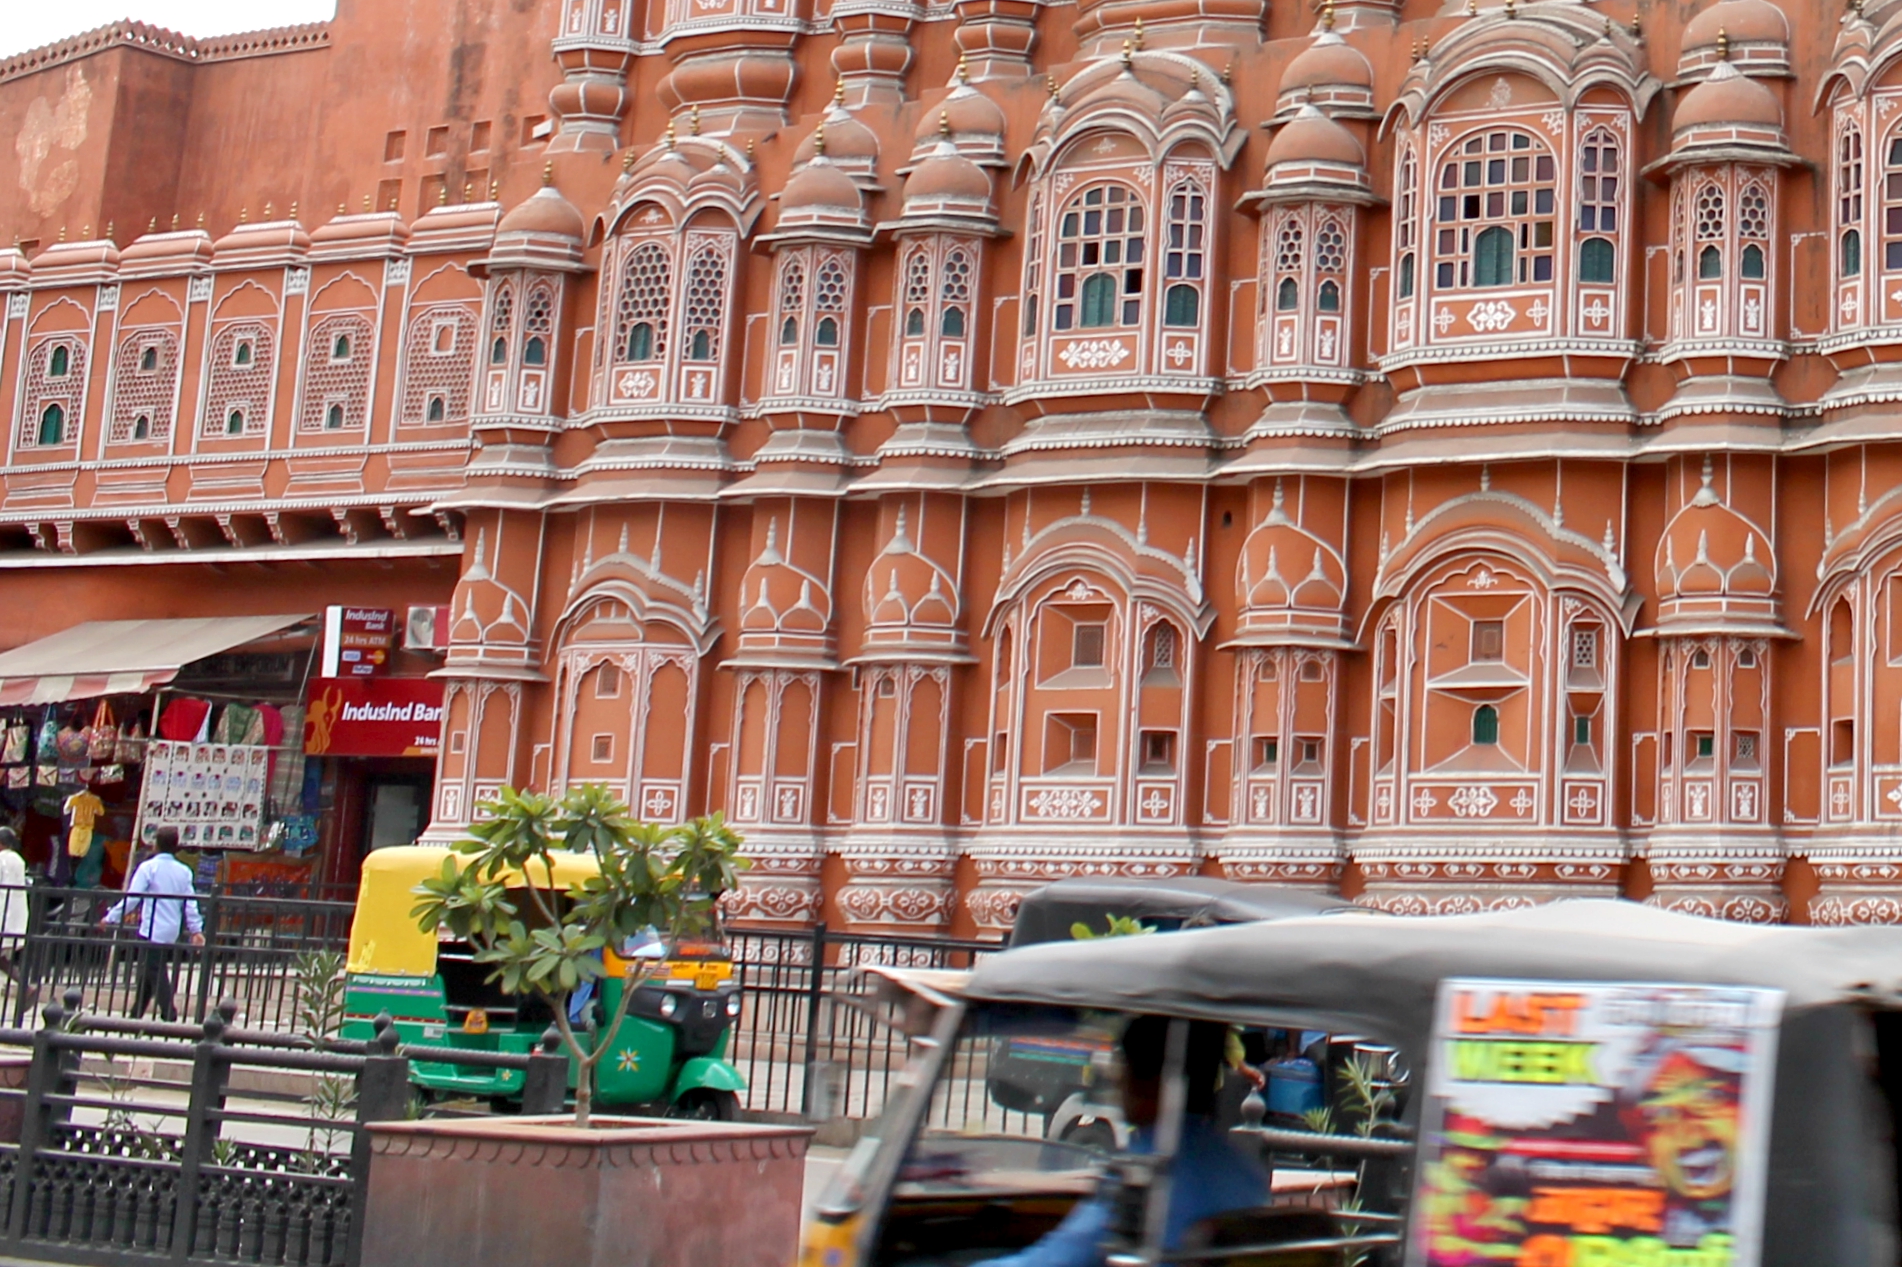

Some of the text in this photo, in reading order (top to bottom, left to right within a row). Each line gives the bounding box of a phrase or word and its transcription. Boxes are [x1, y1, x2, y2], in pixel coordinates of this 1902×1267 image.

[345, 609, 388, 621] IndusInd
[365, 622, 385, 630] Bank
[344, 636, 387, 645] 24 hrs ATM
[342, 701, 443, 721] IndusInd Ban
[1451, 990, 1590, 1035] LAST
[1449, 1040, 1602, 1084] WEEK
